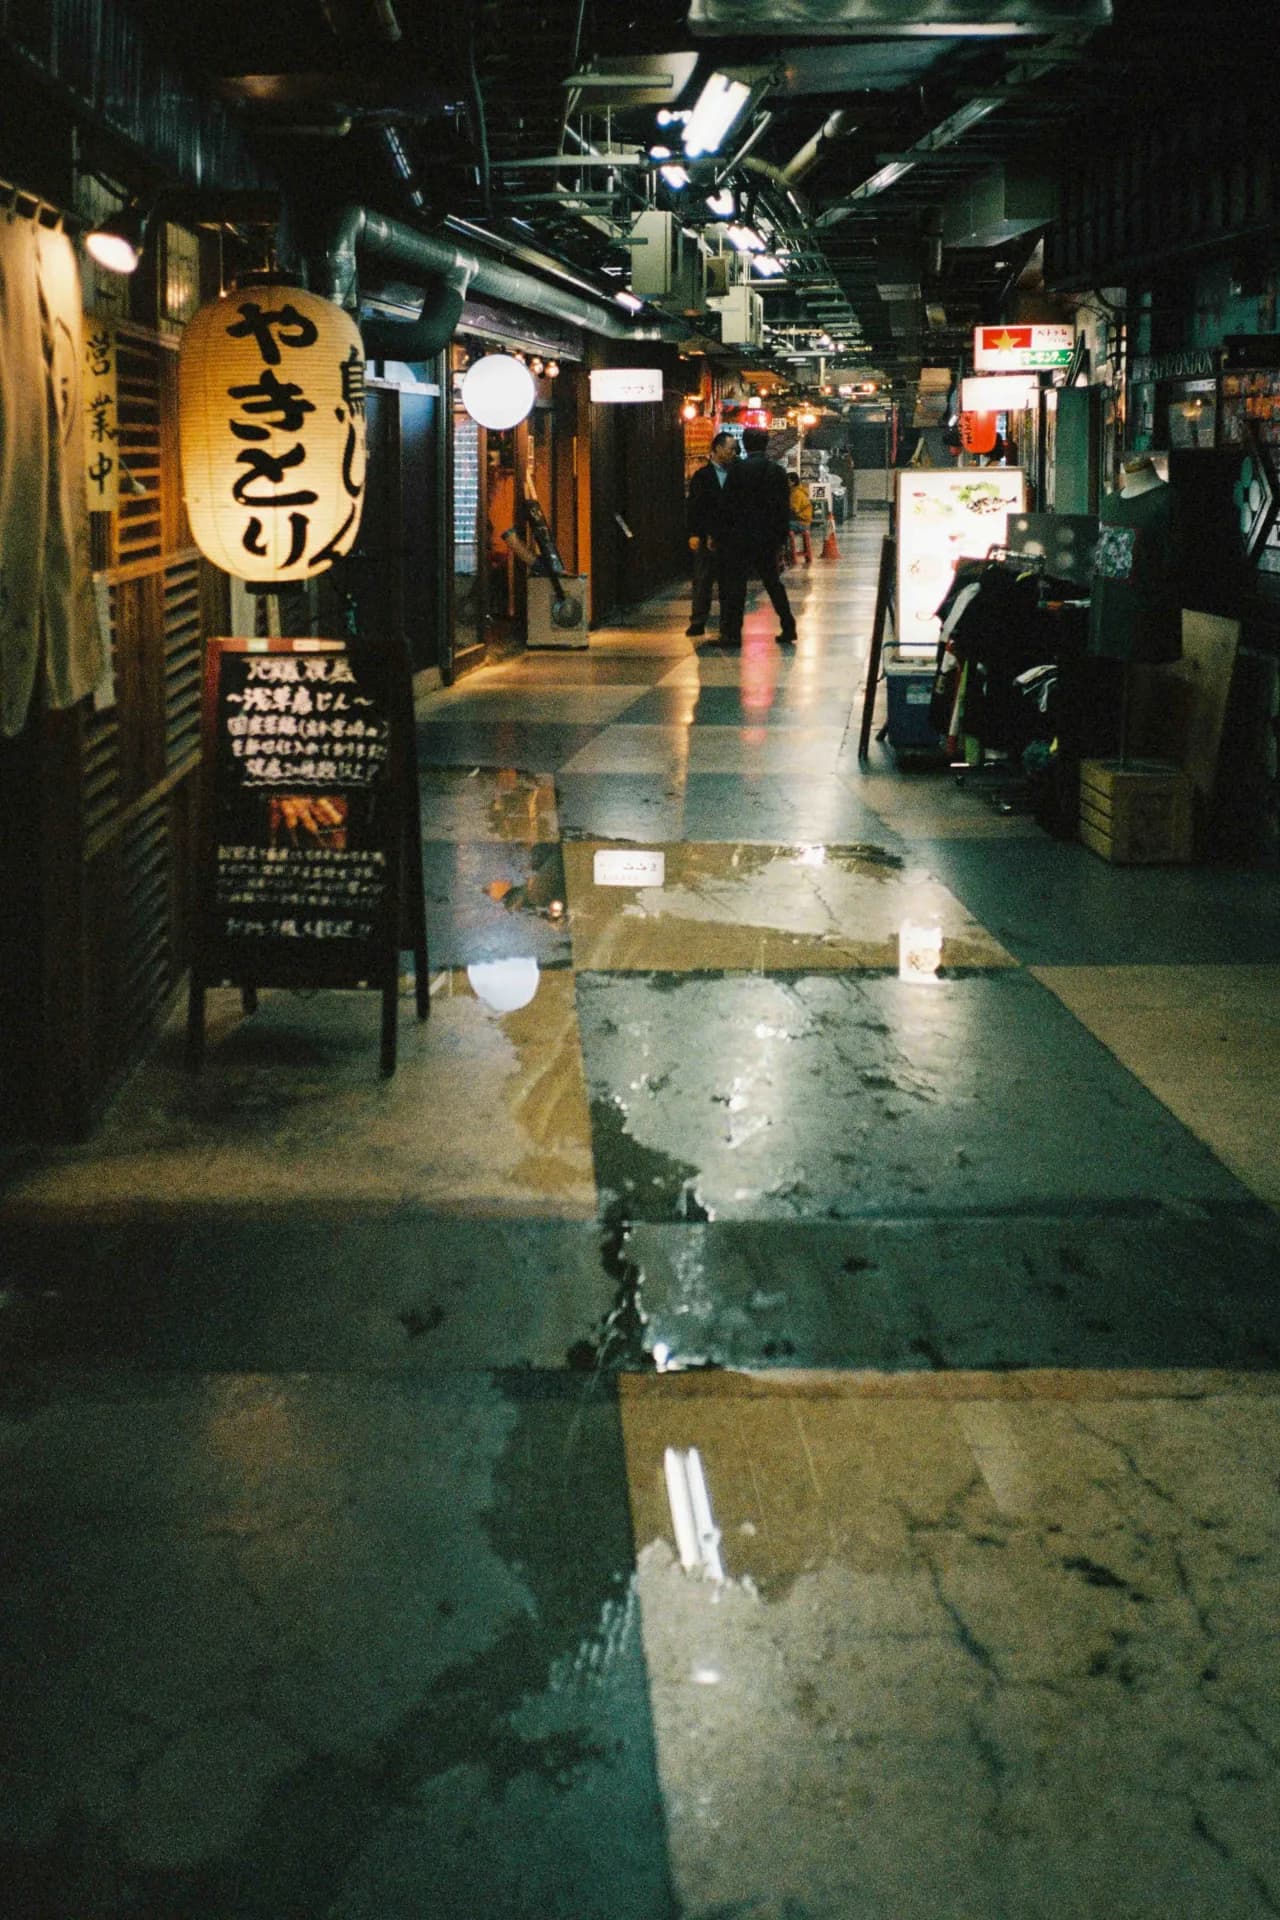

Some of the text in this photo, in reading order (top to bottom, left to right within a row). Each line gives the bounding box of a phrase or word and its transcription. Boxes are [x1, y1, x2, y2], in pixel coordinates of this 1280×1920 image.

[86, 334, 117, 495] 営業中
[226, 302, 319, 569] やきとり
[813, 486, 826, 498] 酒
